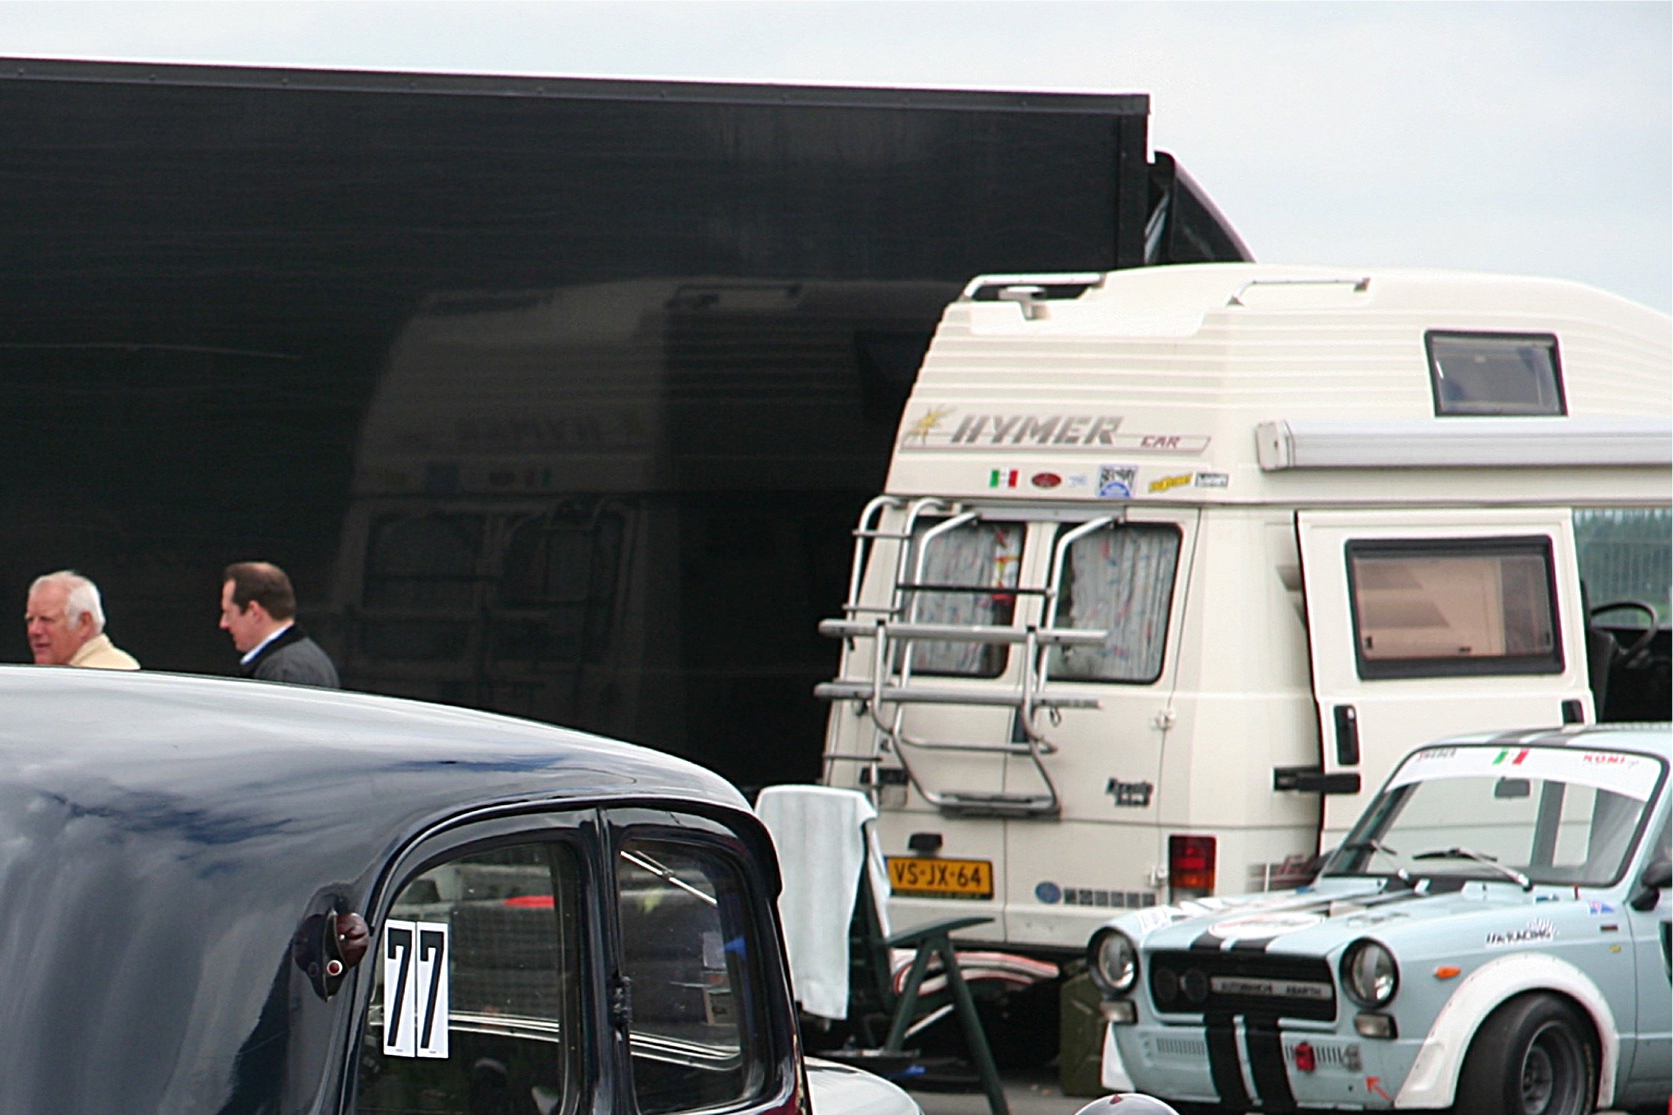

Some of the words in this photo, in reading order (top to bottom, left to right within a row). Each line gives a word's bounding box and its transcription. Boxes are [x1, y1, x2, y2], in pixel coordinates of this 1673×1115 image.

[950, 416, 1125, 445] HYMER
[1141, 436, 1180, 448] CAR
[387, 927, 444, 1049] 77
